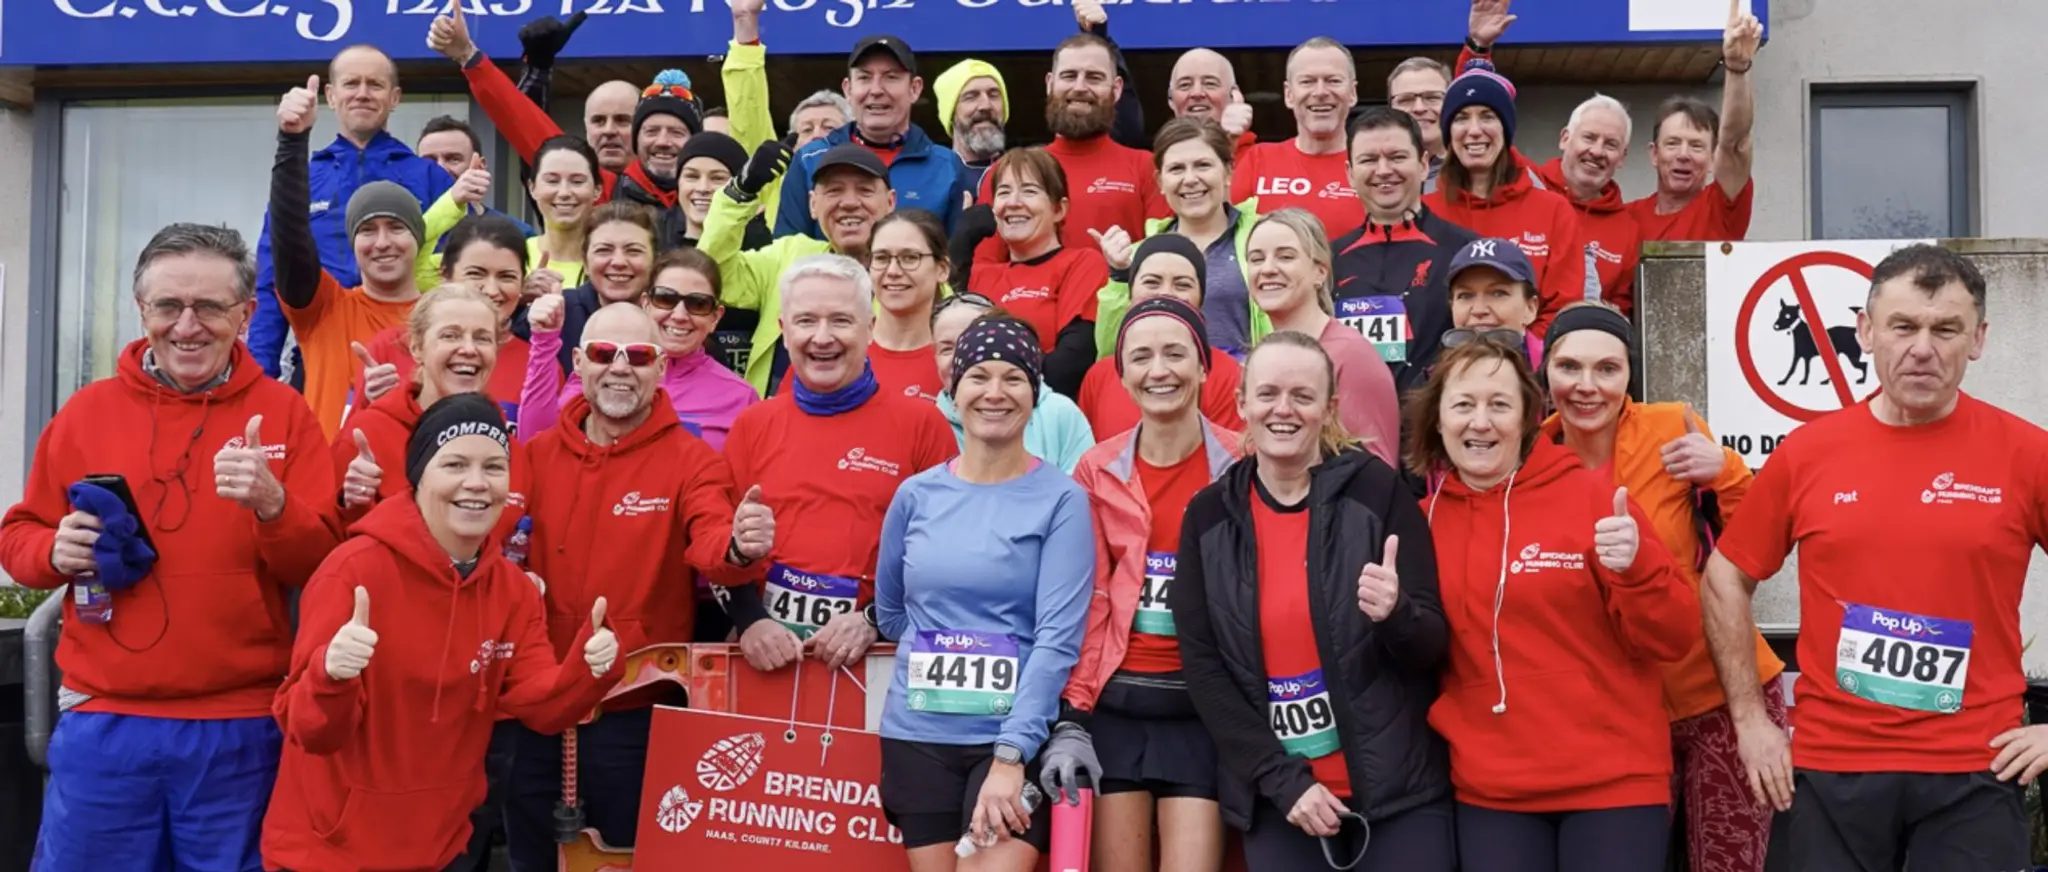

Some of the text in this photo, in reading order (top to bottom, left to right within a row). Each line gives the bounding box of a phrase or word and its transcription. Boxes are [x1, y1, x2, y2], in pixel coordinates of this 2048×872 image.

[1256, 176, 1311, 196] LEO
[1721, 434, 1753, 455] NO
[1834, 490, 1859, 505] Pat
[782, 568, 818, 589] Pop Up
[1871, 611, 1922, 635] Pop Up
[934, 633, 974, 650] Pop Up
[1861, 638, 1966, 685] 4087
[926, 655, 1013, 691] 4419
[1268, 680, 1301, 697] Pop Up
[1273, 697, 1333, 737] 409
[764, 771, 882, 808] BRENDA
[708, 797, 836, 836] RUNNING
[705, 829, 738, 842] NAAS,
[741, 833, 782, 847] COUNTY
